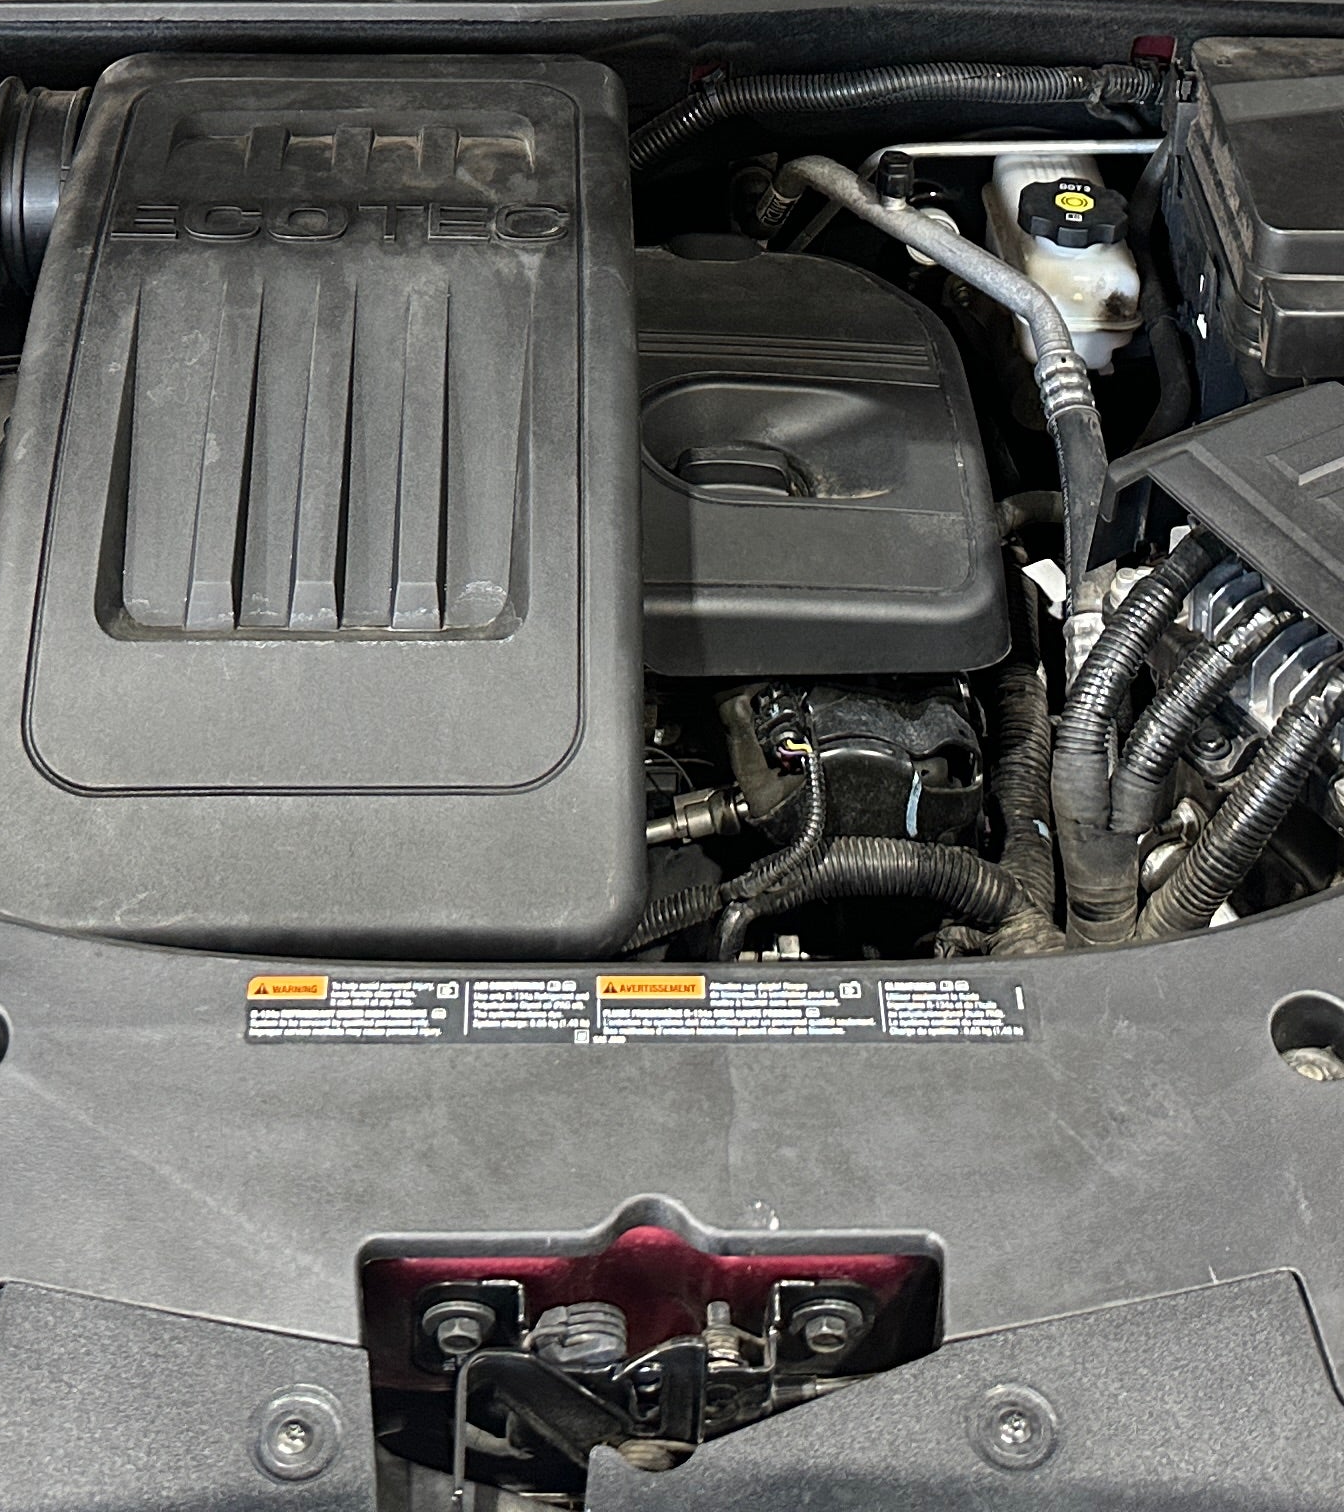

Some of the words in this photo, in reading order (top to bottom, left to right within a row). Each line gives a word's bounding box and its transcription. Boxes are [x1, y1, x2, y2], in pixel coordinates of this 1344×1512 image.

[110, 202, 571, 244] ECOTEC
[272, 984, 318, 994] WARNING
[619, 984, 696, 993] AVERTISSEMENT
